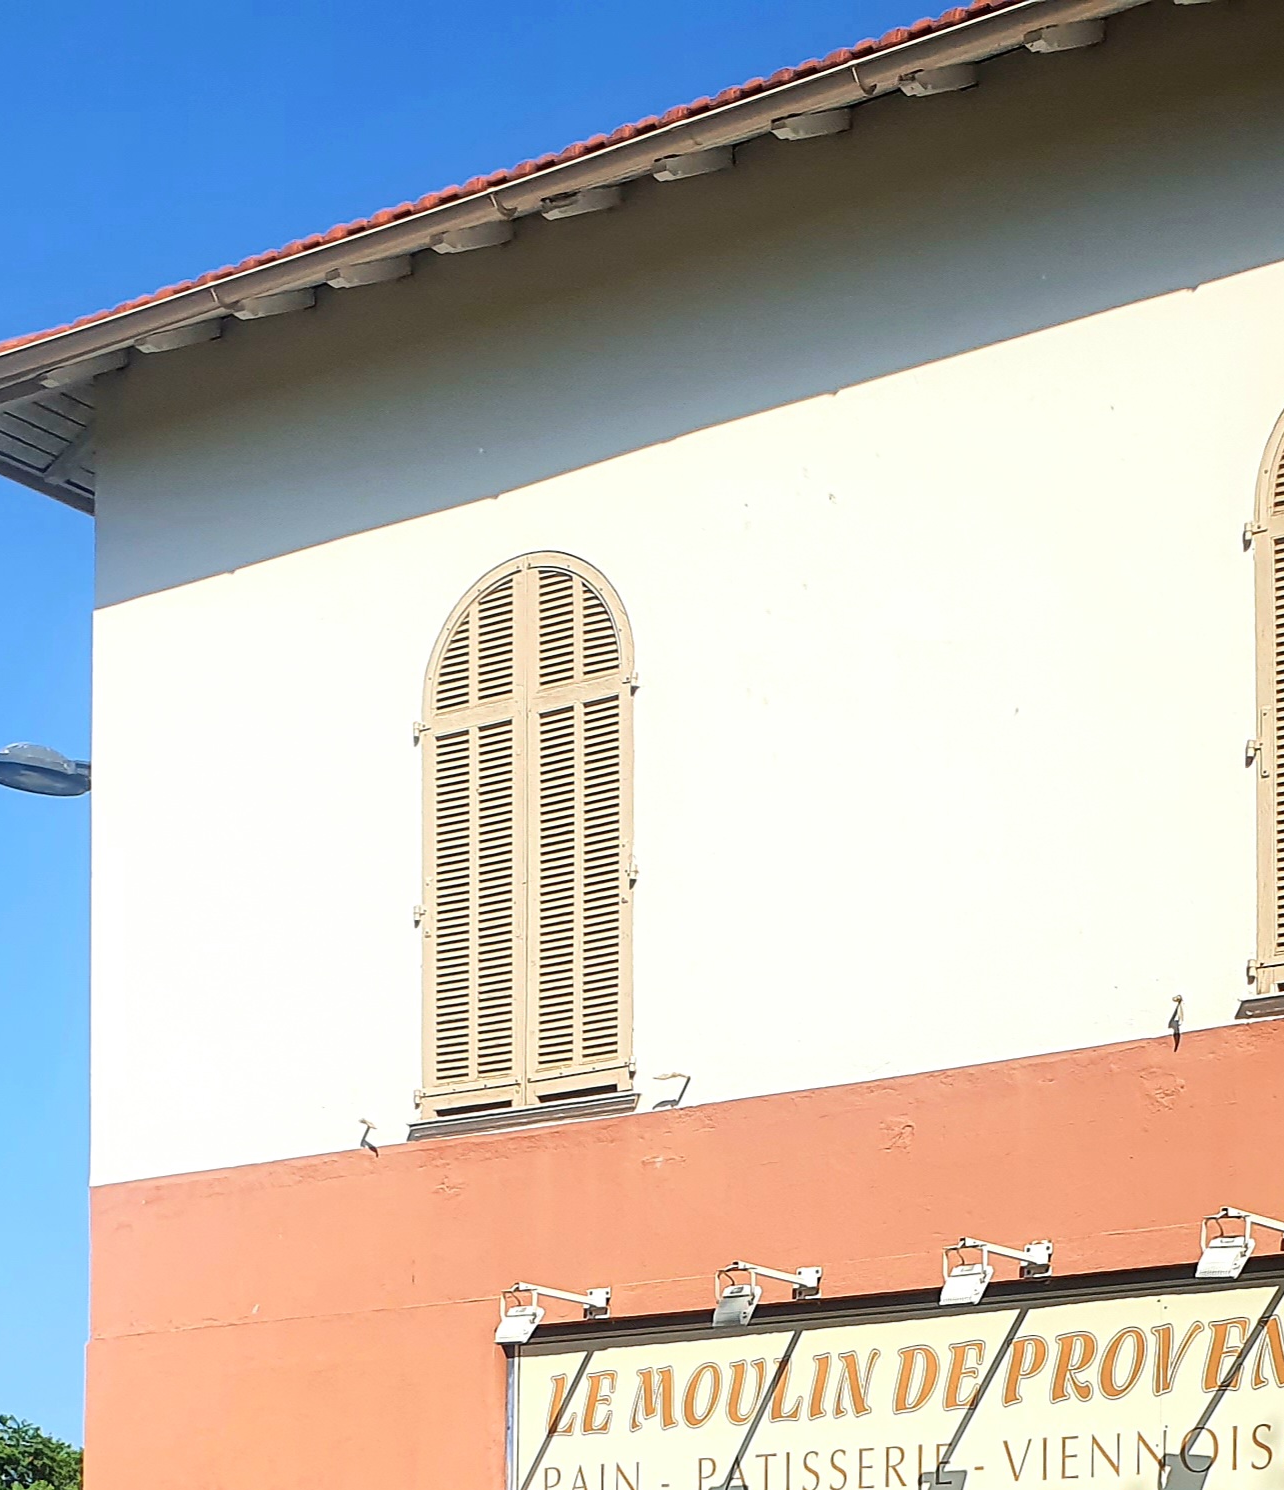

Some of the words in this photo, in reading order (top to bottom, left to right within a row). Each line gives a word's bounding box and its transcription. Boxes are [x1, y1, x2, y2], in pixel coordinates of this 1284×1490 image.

[545, 1369, 618, 1436] LE
[629, 1349, 881, 1433] MOULIN
[892, 1339, 986, 1415] DE
